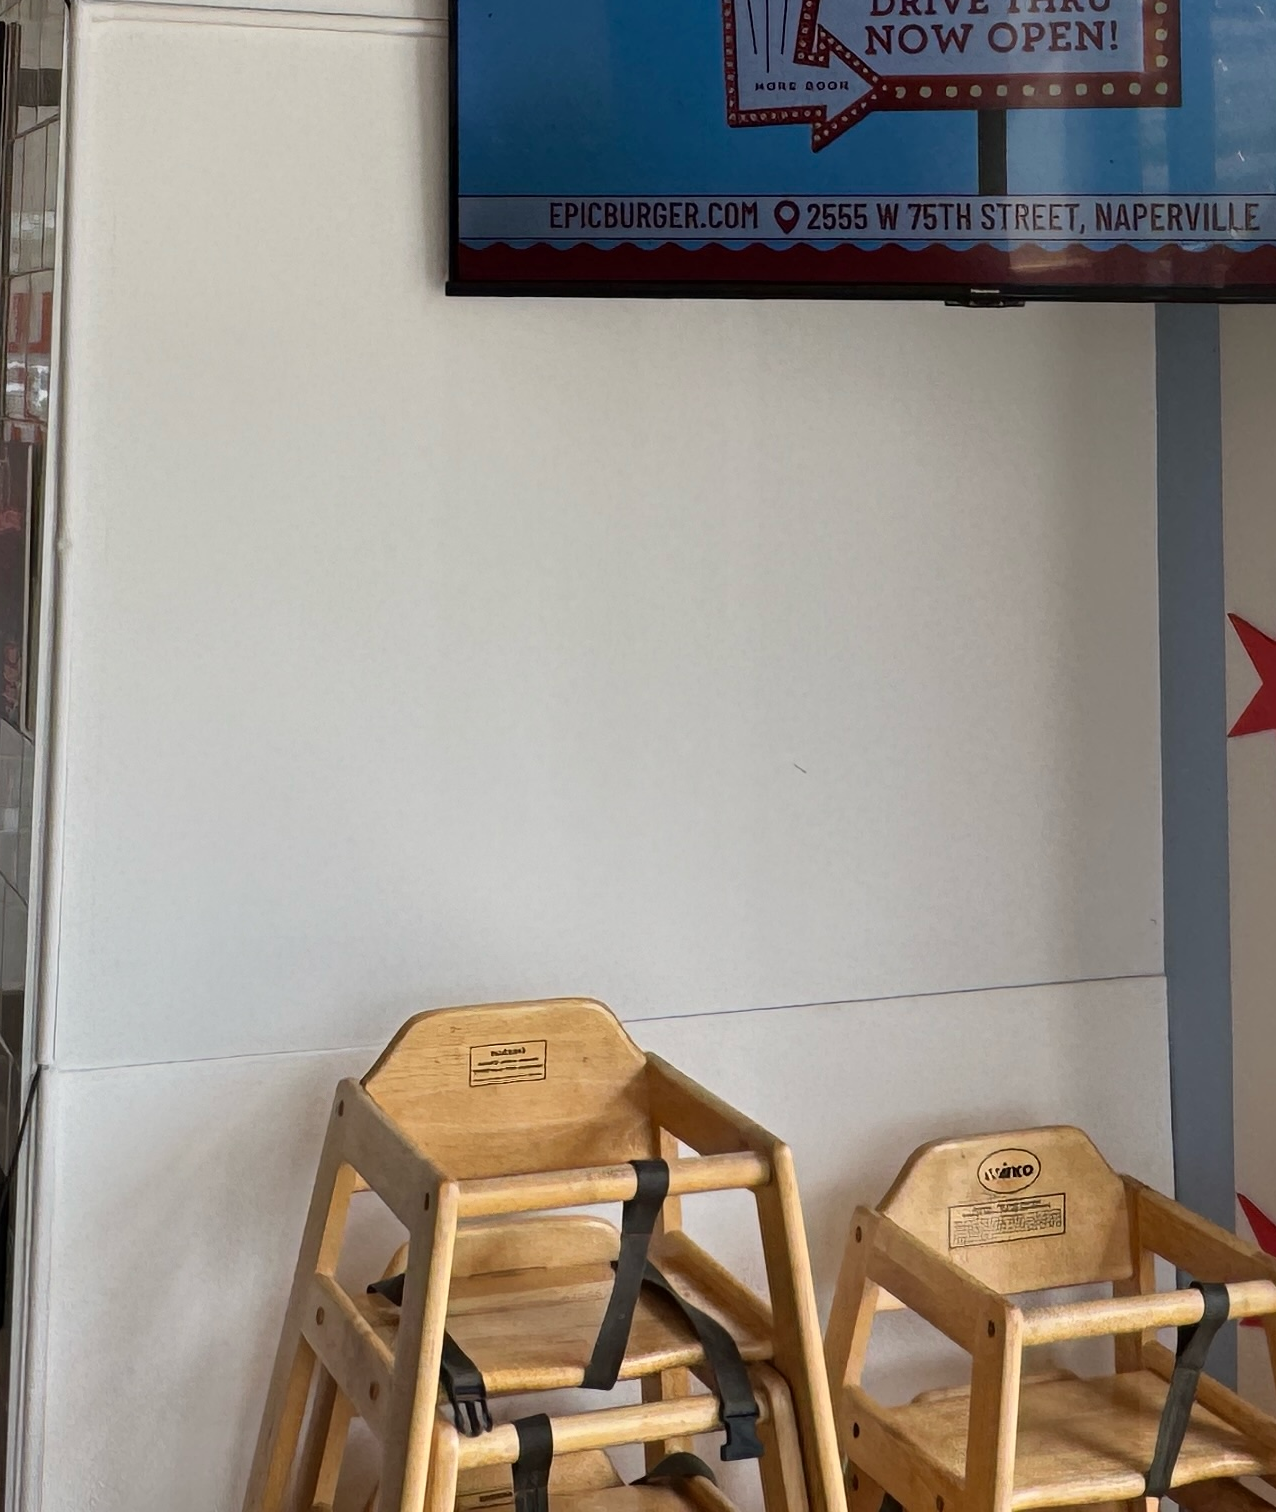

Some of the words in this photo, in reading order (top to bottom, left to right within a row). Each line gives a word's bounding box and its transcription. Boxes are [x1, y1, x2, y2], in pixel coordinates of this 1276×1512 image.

[865, 23, 973, 55] NOW
[987, 20, 1118, 53] OPEN!
[548, 200, 759, 230] EPICBURGER.COM
[806, 202, 868, 231] 2555
[877, 202, 898, 230] W
[907, 202, 972, 230] 75TH
[980, 202, 1086, 235] STREET,
[1095, 202, 1260, 231] NAPERVILLE
